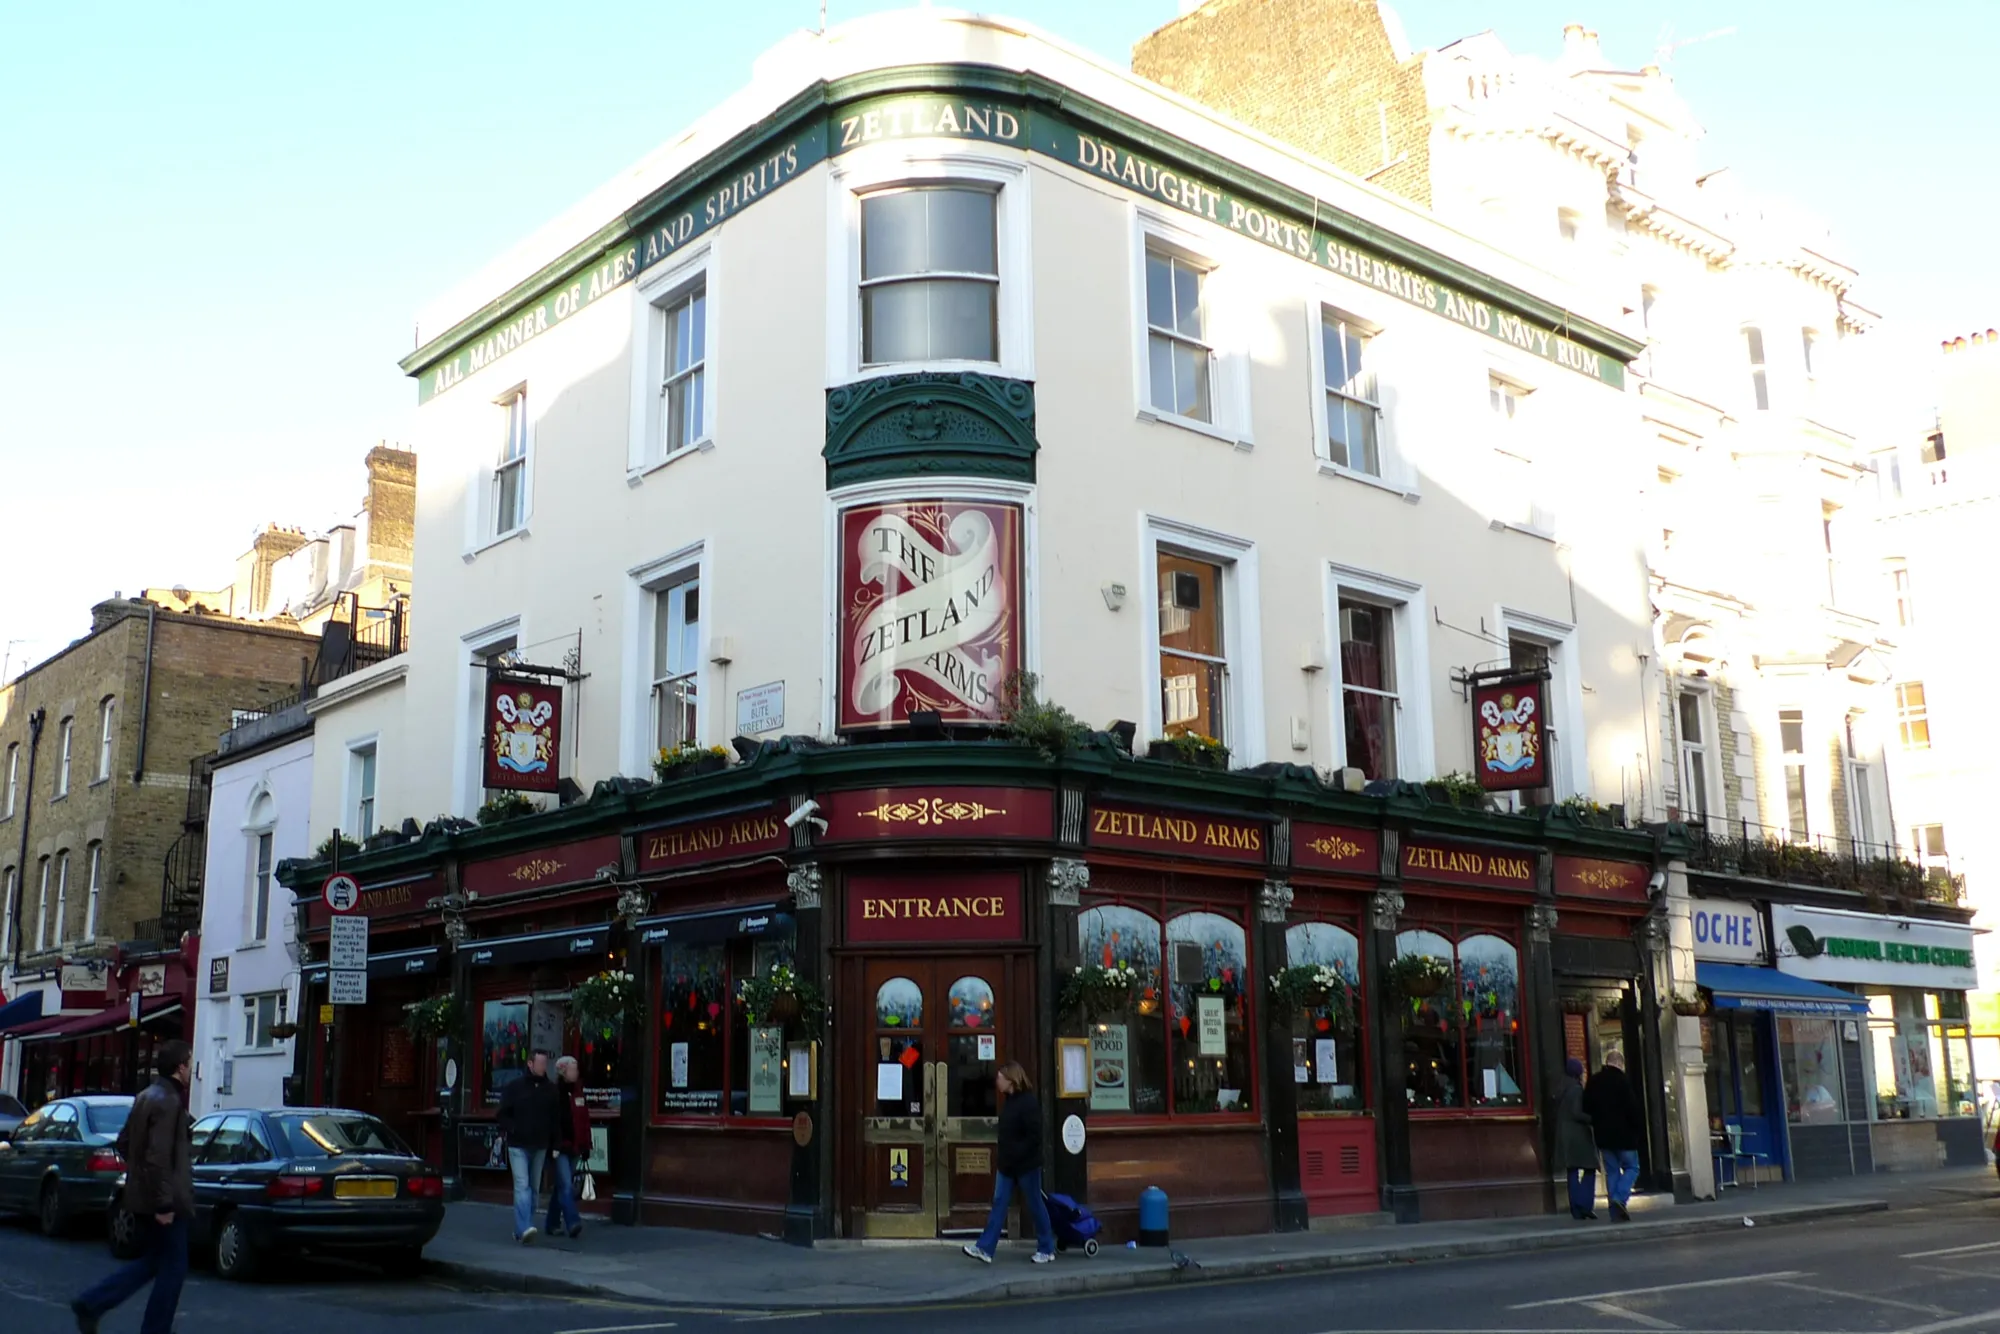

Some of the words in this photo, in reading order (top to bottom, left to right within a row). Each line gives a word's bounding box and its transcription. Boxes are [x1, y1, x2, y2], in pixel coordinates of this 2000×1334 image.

[840, 103, 1019, 148] ZETLAND
[434, 358, 463, 395] ALL
[468, 305, 549, 373] MANNER
[555, 282, 581, 319] OF
[587, 247, 636, 301] ALES
[644, 213, 694, 265] AND
[705, 144, 798, 225] SPIRITS
[1077, 135, 1221, 219] DRAUGHT
[1327, 241, 1436, 309] SHERRIES
[1444, 291, 1490, 330] AND
[1497, 313, 1550, 356] NAVY
[1556, 338, 1600, 377] RUM
[873, 527, 935, 584] THE
[860, 564, 994, 667] ZETLAND
[924, 651, 989, 705] ARMS
[739, 719, 763, 735] STREET
[649, 826, 723, 859] ZETLAND
[729, 815, 779, 845] ARMS
[1094, 809, 1197, 843] ZETLAND
[1204, 823, 1260, 850] ARMS
[1406, 846, 1482, 874] ZETLAND
[1488, 856, 1529, 880] ARMS
[384, 885, 412, 907] ARMS
[863, 896, 1005, 919] ENTRANCE
[335, 917, 364, 925] Saturday
[333, 987, 362, 995] Saturday
[1094, 1040, 1123, 1051] FOOD
